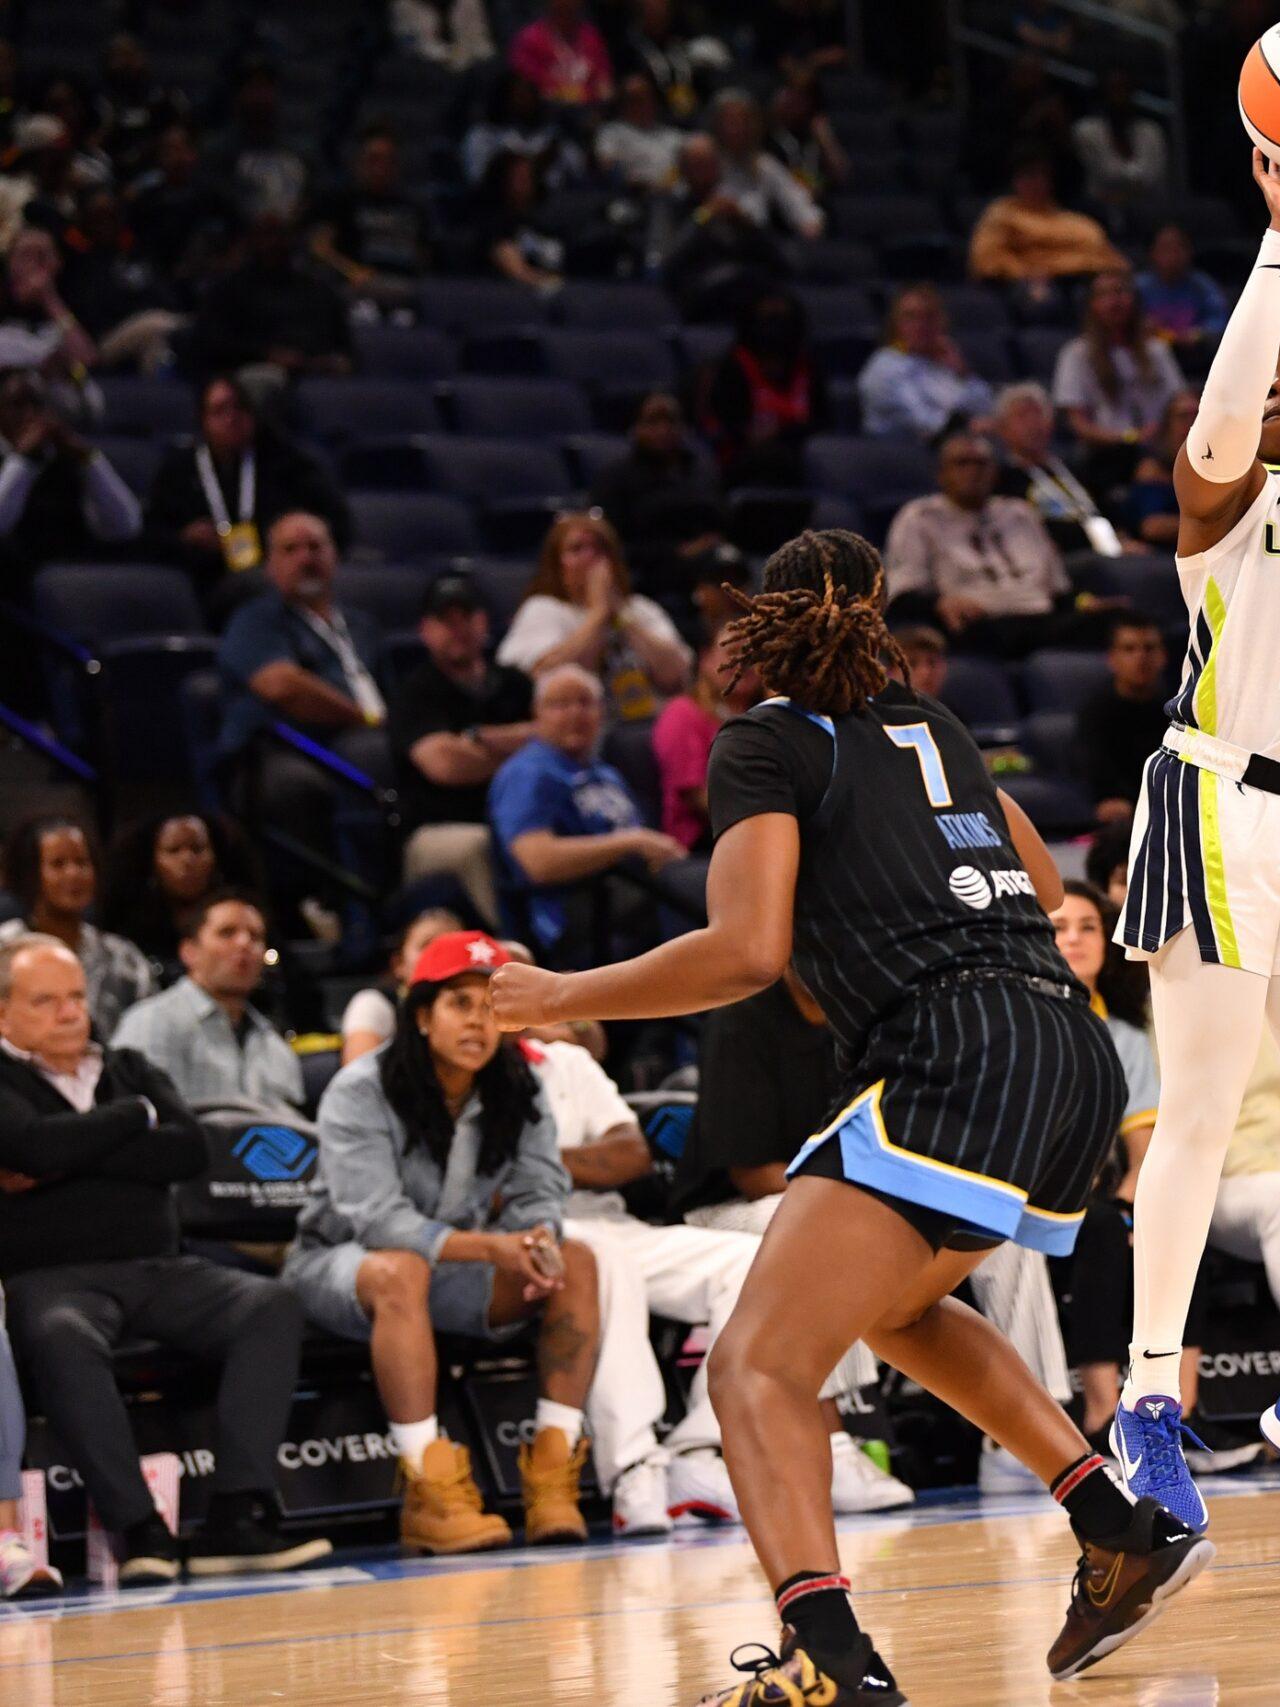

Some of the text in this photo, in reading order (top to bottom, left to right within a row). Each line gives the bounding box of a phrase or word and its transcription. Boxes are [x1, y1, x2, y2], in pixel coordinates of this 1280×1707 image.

[883, 721, 954, 808] 7
[934, 811, 1002, 850] ATKINS
[990, 869, 1037, 899] AT&
